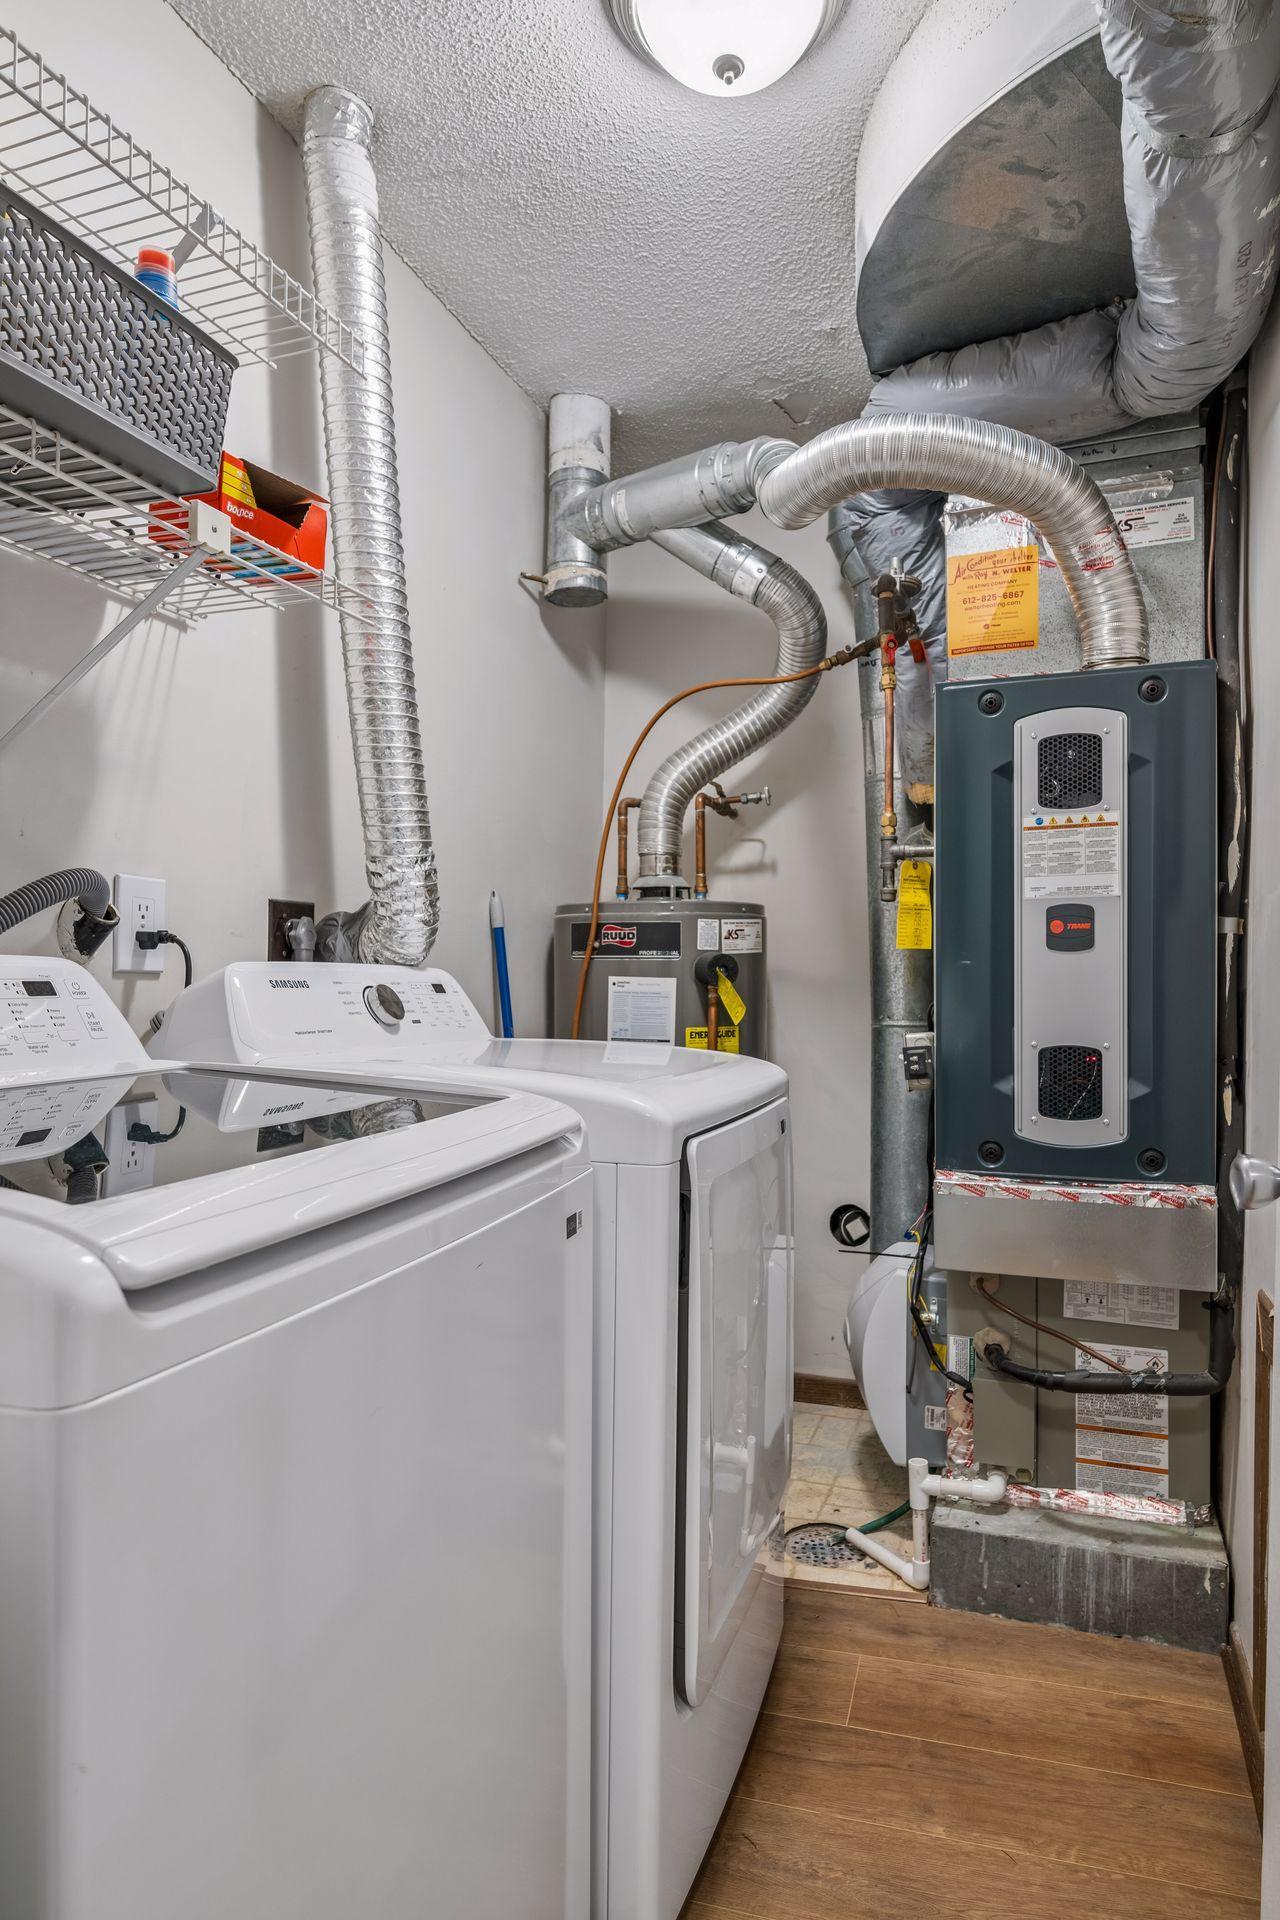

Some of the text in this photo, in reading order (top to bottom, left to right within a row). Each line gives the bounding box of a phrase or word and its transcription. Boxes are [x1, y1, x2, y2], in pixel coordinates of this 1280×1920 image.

[226, 501, 254, 518] bounce
[967, 553, 998, 572] Condition
[1002, 565, 1032, 575] WELTER
[967, 582, 990, 590] HEATING
[990, 579, 1018, 588] COMPANY
[962, 590, 1025, 605] 612-825-6867
[964, 600, 1021, 612] welterheating.com
[603, 932, 636, 941] RUUD
[269, 979, 310, 989] SAMSUNG
